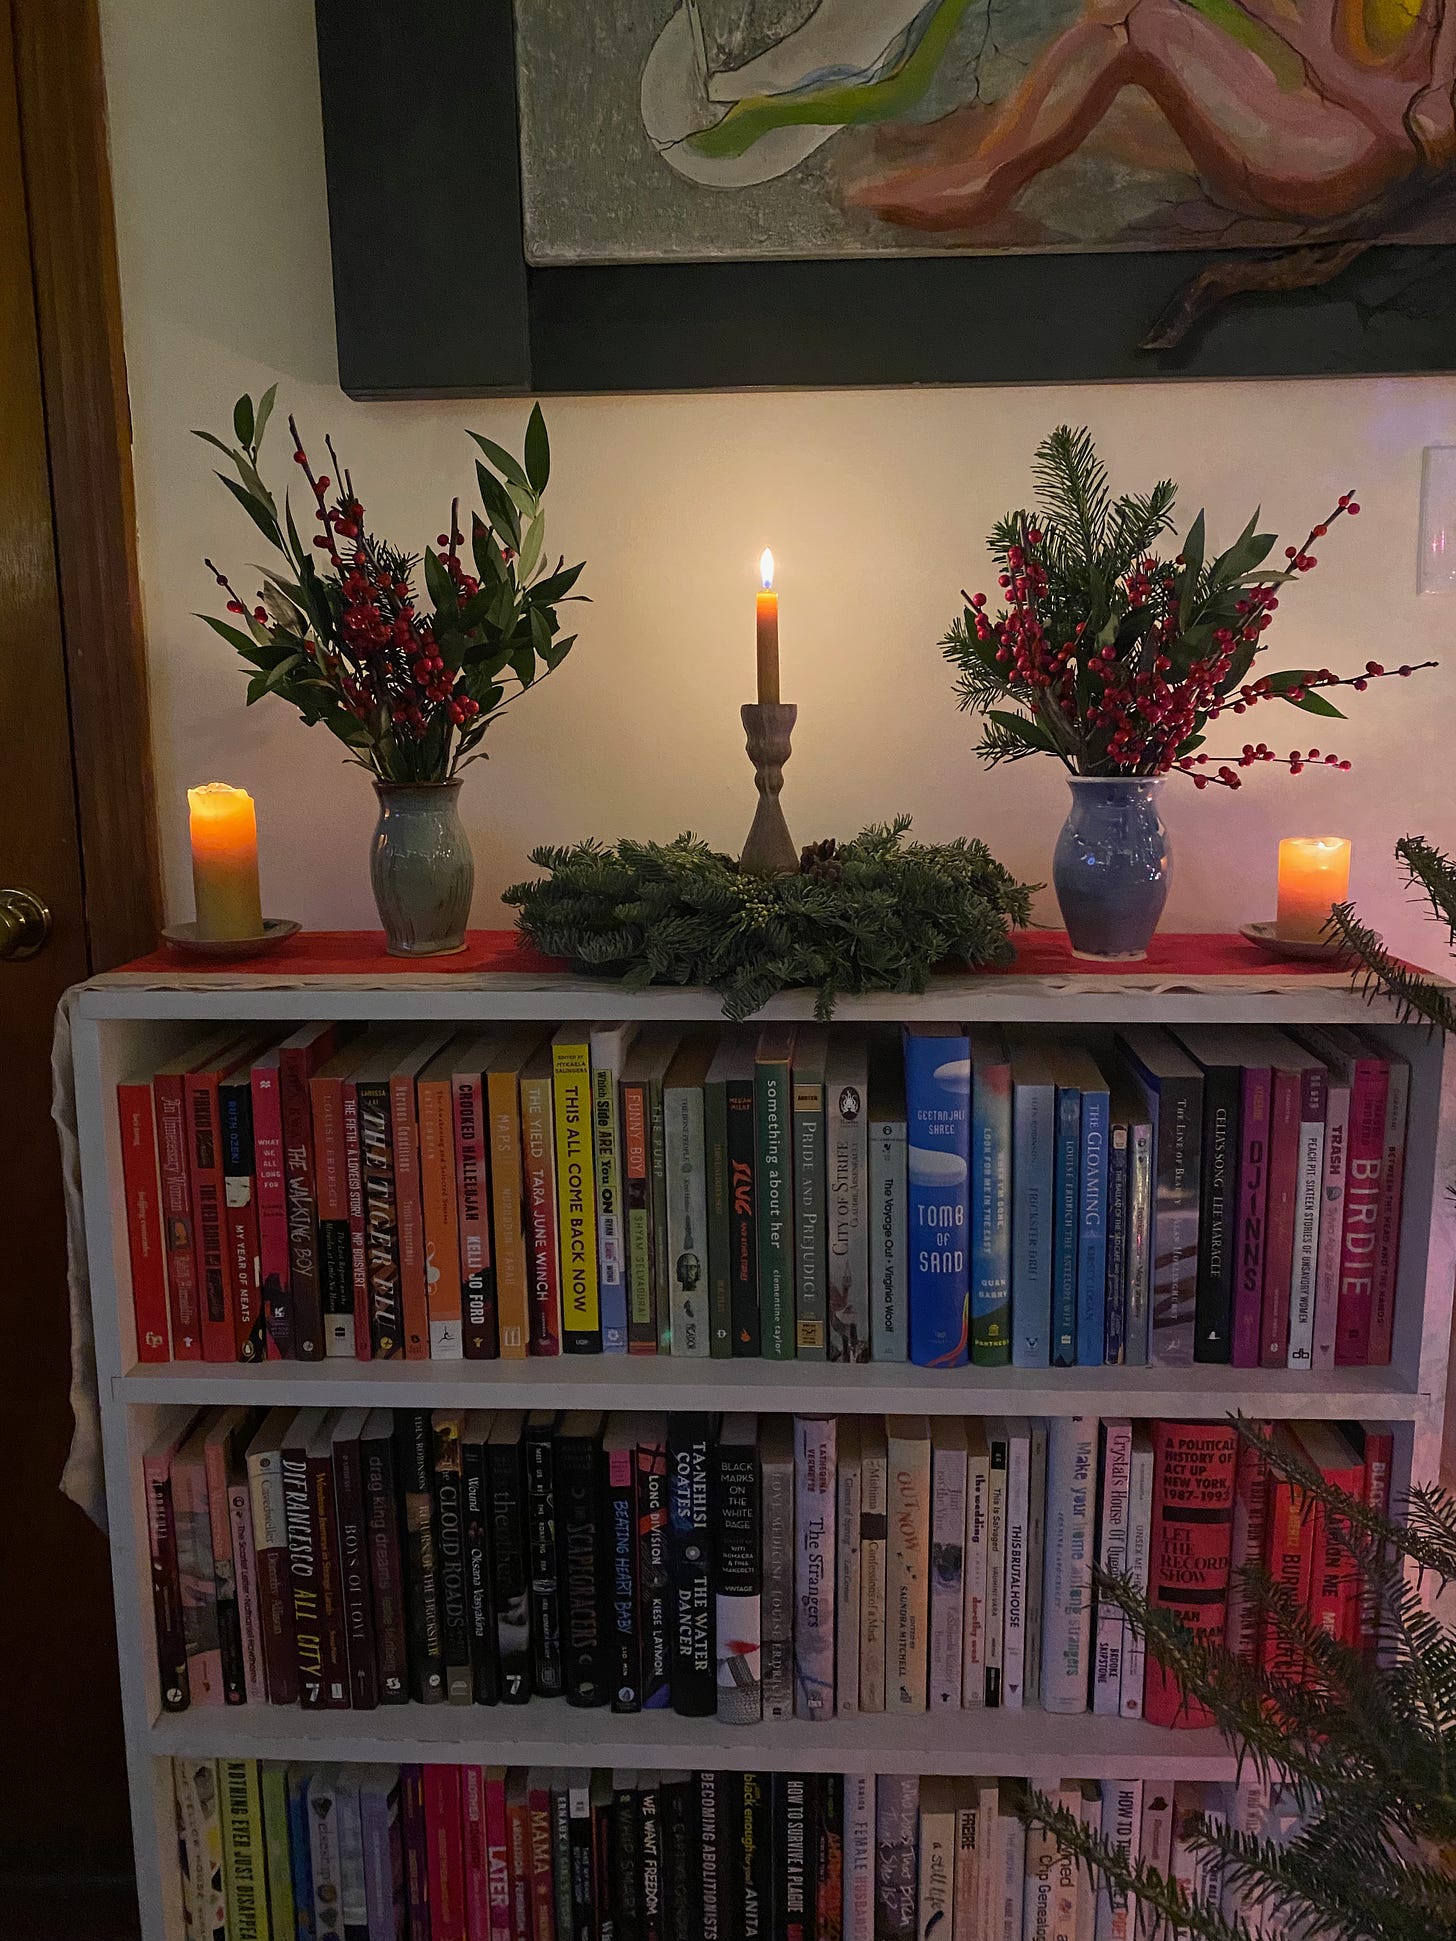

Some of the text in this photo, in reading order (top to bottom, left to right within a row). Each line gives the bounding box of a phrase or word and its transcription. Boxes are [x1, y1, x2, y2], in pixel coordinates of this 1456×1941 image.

[227, 1100, 239, 1164] RUTH OZEKI
[344, 1100, 357, 1116] THE
[345, 1118, 358, 1142] FIFTH
[498, 1114, 511, 1151] MAPS
[529, 1088, 542, 1157] THE YIELD
[628, 1095, 643, 1172] FUNNY BOY
[652, 1104, 663, 1177] THE PUMP
[347, 1158, 360, 1190] LOVE(S)
[459, 1084, 479, 1220] CROOKED HALLELUJAH
[597, 1072, 613, 1214] Which Side ARE You ON
[766, 1080, 783, 1248] something about her
[1086, 1105, 1101, 1226] THE GLOAMING
[1214, 1108, 1226, 1187] CELIA'S SONG
[1308, 1138, 1317, 1161] PEACH
[1330, 1125, 1342, 1174] TRASH
[288, 1144, 313, 1276] THE WALKING BOY
[349, 1192, 361, 1217] STORY
[363, 1110, 396, 1330] THE TIGER FLU
[566, 1086, 586, 1312] THIS ALL COME BACK NOW
[802, 1121, 817, 1302] PRIDE AND PREJUDICE
[918, 1205, 964, 1226] TOMB
[1243, 1141, 1263, 1291] DJINNS
[1303, 1213, 1313, 1242] STORIES
[1305, 1180, 1315, 1210] SIXTEEN
[1343, 1159, 1380, 1295] BIRDIE
[353, 1232, 365, 1288] MP BOISVERT
[533, 1170, 548, 1300] TARA JUNE WINCH
[883, 1178, 894, 1332] The Voyage Out Virginia Woolf
[919, 1252, 963, 1272] SAND
[937, 1233, 950, 1246] OF
[1210, 1197, 1224, 1277] LEE MARACLE
[1303, 1245, 1312, 1254] OF
[236, 1226, 249, 1322] MY YEAR OF MEATS
[467, 1236, 484, 1324] KELLI JO FORD
[1300, 1256, 1310, 1293] UNSAVORY
[773, 1270, 783, 1353] clementine taylor
[1299, 1295, 1309, 1323] WOMEN
[721, 1462, 752, 1470] BLACK
[1075, 1442, 1091, 1480] Make
[1165, 1452, 1232, 1464] HISTORY OF
[1166, 1438, 1234, 1451] A POLITICAL
[468, 1477, 479, 1511] Wound
[677, 1452, 690, 1517] COATES
[693, 1441, 706, 1528] TA-NEHISI
[869, 1468, 878, 1510] Mishima
[897, 1472, 919, 1551] OUT NOW
[972, 1475, 983, 1543] the wedding
[993, 1505, 1000, 1513] Is
[1070, 1487, 1089, 1517] your
[1109, 1435, 1130, 1541] Crystal's House Of
[649, 1475, 660, 1565] LONG DIVISION
[991, 1515, 1000, 1551] Salvaged
[283, 1460, 321, 1676] DIFRANCESCO ALL CITY
[440, 1487, 462, 1627] CLOUD ROADS
[613, 1501, 632, 1634] BEATING HEART BABY
[803, 1518, 825, 1627] The Strangers
[869, 1542, 878, 1597] Confessions
[471, 1549, 485, 1636] Oksana Vasyakina
[679, 1589, 691, 1655] DANCER
[694, 1577, 707, 1670] THE WATER
[653, 1599, 663, 1676] KIESE LAYMON
[899, 1586, 908, 1677] SAUNDRA MITCHELL
[1065, 1620, 1082, 1676] strangers
[1098, 1642, 1108, 1683] SKIPSTONE
[1109, 1649, 1119, 1677] BROOKE
[228, 1763, 253, 1880] NOTHING EVER JUST
[741, 1774, 755, 1864] black enough for
[788, 1782, 803, 1803] HOW
[788, 1808, 803, 1818] TO
[1118, 1792, 1133, 1835] HOW TO
[531, 1811, 549, 1874] MAMA
[642, 1795, 658, 1915] WE WANT FREEDOM
[701, 1773, 717, 1940] BECOMING ABOLITIONISTS
[788, 1823, 803, 1864] SURVIVE
[488, 1846, 508, 1906] LATER
[788, 1877, 803, 1912] PLAGUE
[745, 1888, 758, 1937] ANITA
